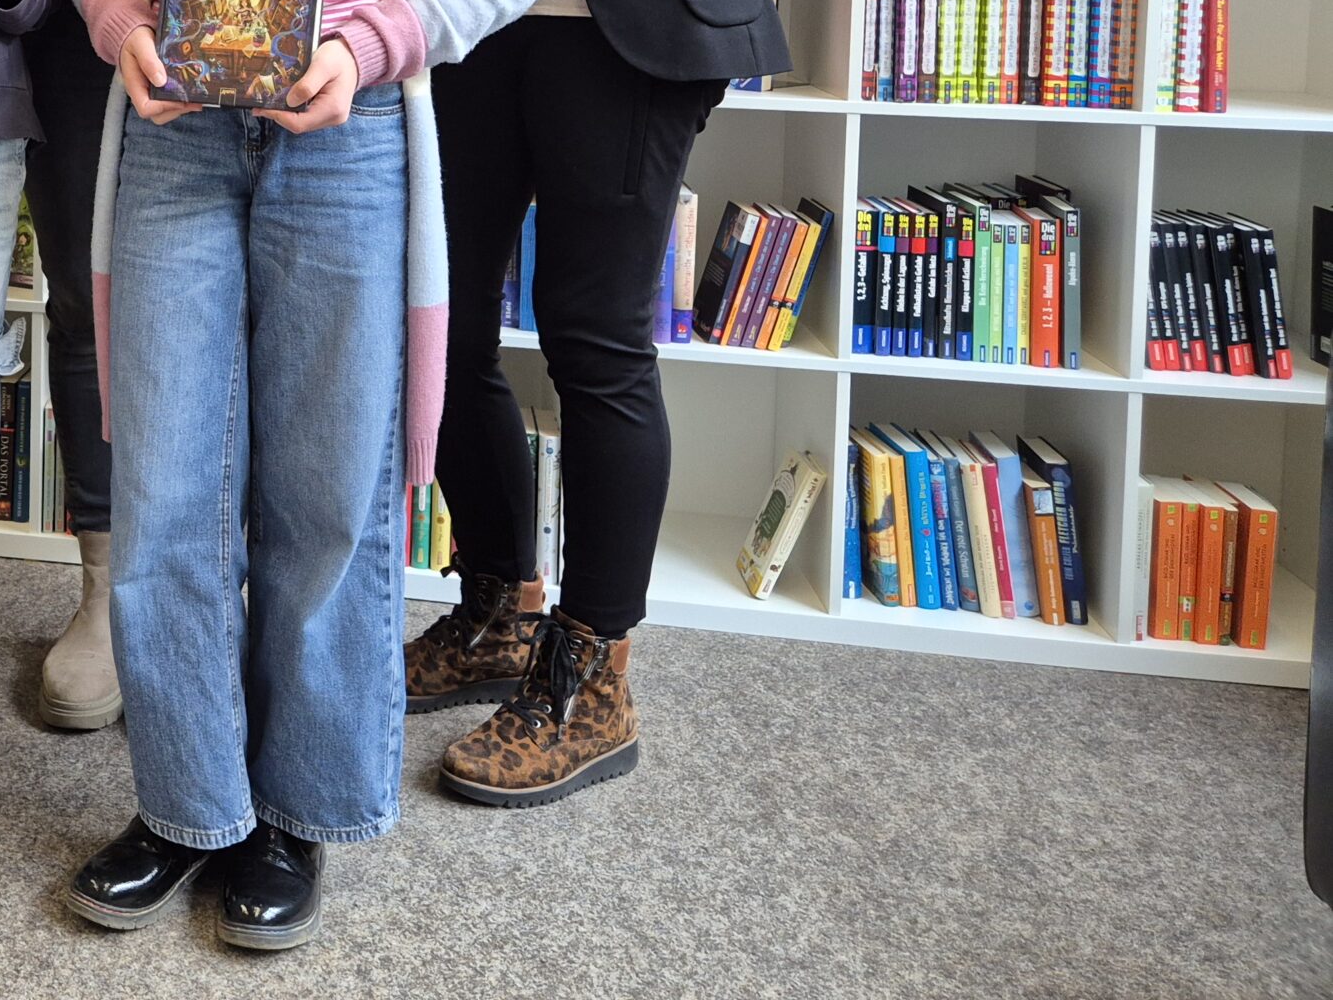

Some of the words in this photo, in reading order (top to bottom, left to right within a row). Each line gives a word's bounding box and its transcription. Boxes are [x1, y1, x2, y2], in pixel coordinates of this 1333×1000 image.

[1041, 222, 1055, 234] Die
[1041, 233, 1055, 241] drei
[858, 252, 868, 277] Gefahr!
[882, 254, 892, 283] Spionage!
[899, 255, 908, 277] Lagune
[915, 255, 923, 276] Gefahr
[963, 258, 971, 279] Action!
[898, 278, 906, 288] der
[944, 263, 954, 304] Himmelszeichen
[963, 280, 971, 291] und
[881, 285, 892, 310] Achtung,
[897, 295, 906, 312] Diebe
[914, 284, 923, 317] Fußballstar
[962, 292, 972, 312] Klappe
[943, 304, 953, 335] Rätselhafte
[0, 436, 7, 456] DAS
[0, 458, 9, 498] PORTAL
[1053, 481, 1066, 506] MOON
[1055, 507, 1070, 544] FLETCHER
